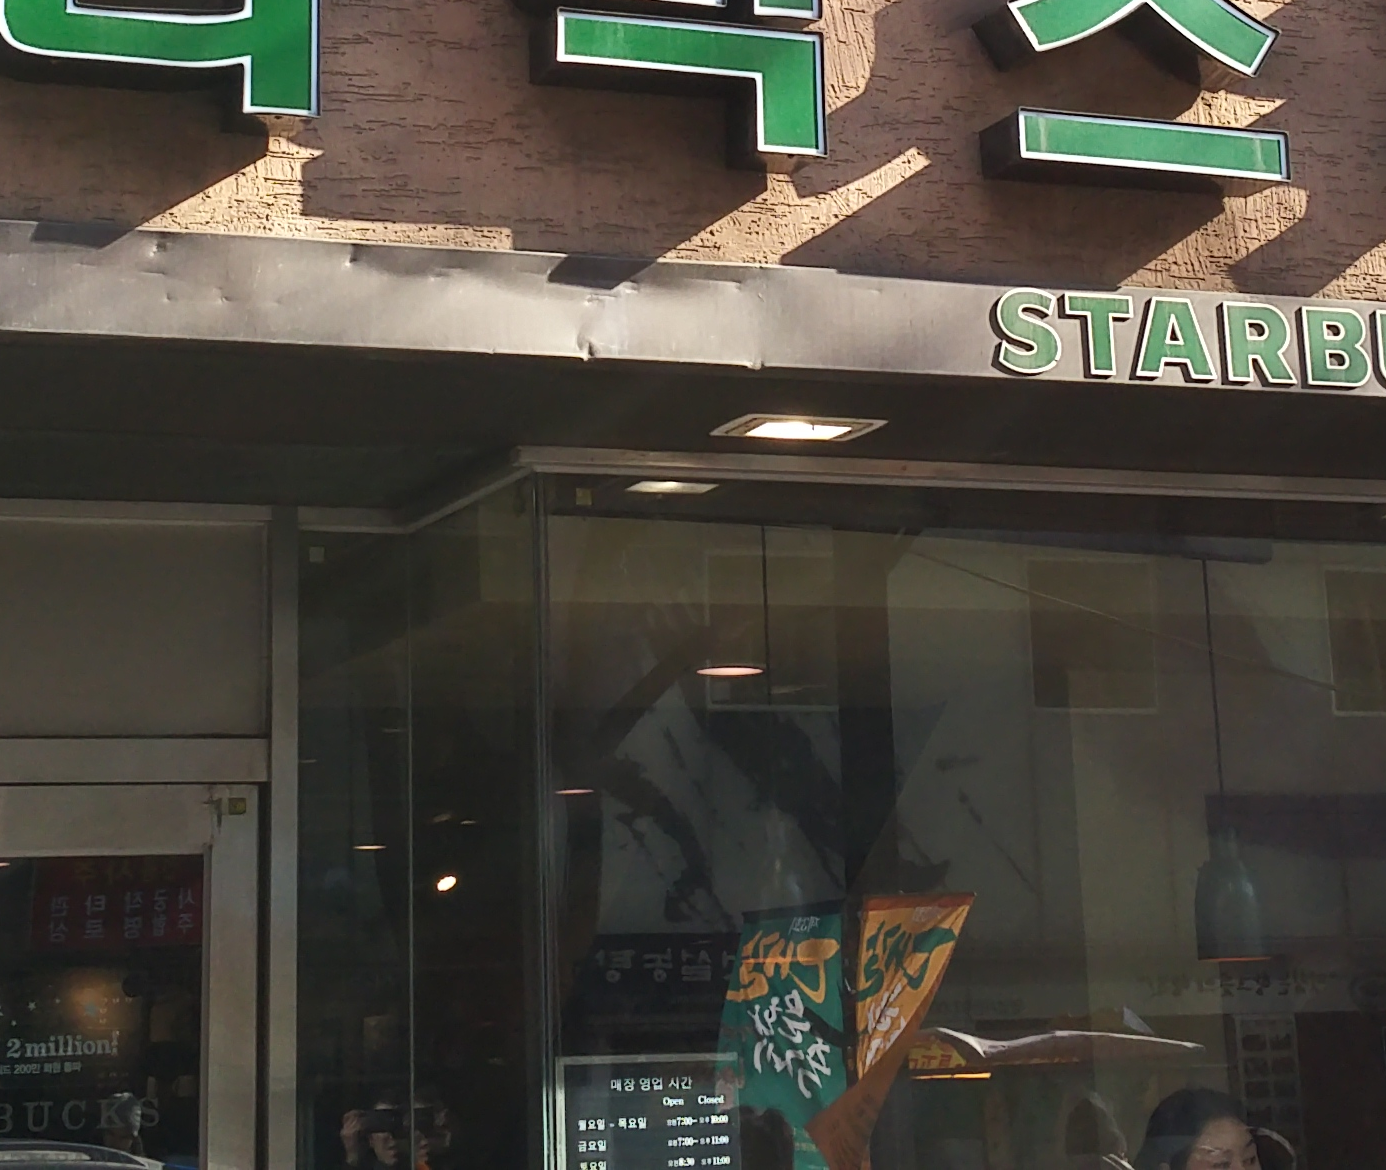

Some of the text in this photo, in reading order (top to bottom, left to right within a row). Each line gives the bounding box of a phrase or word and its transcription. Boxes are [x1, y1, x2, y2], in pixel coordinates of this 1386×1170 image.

[610, 1076, 693, 1092] 매장 영업 시간
[662, 1095, 725, 1107] Open Closed
[618, 1116, 647, 1130] 목요일
[577, 1139, 607, 1153] 금요일
